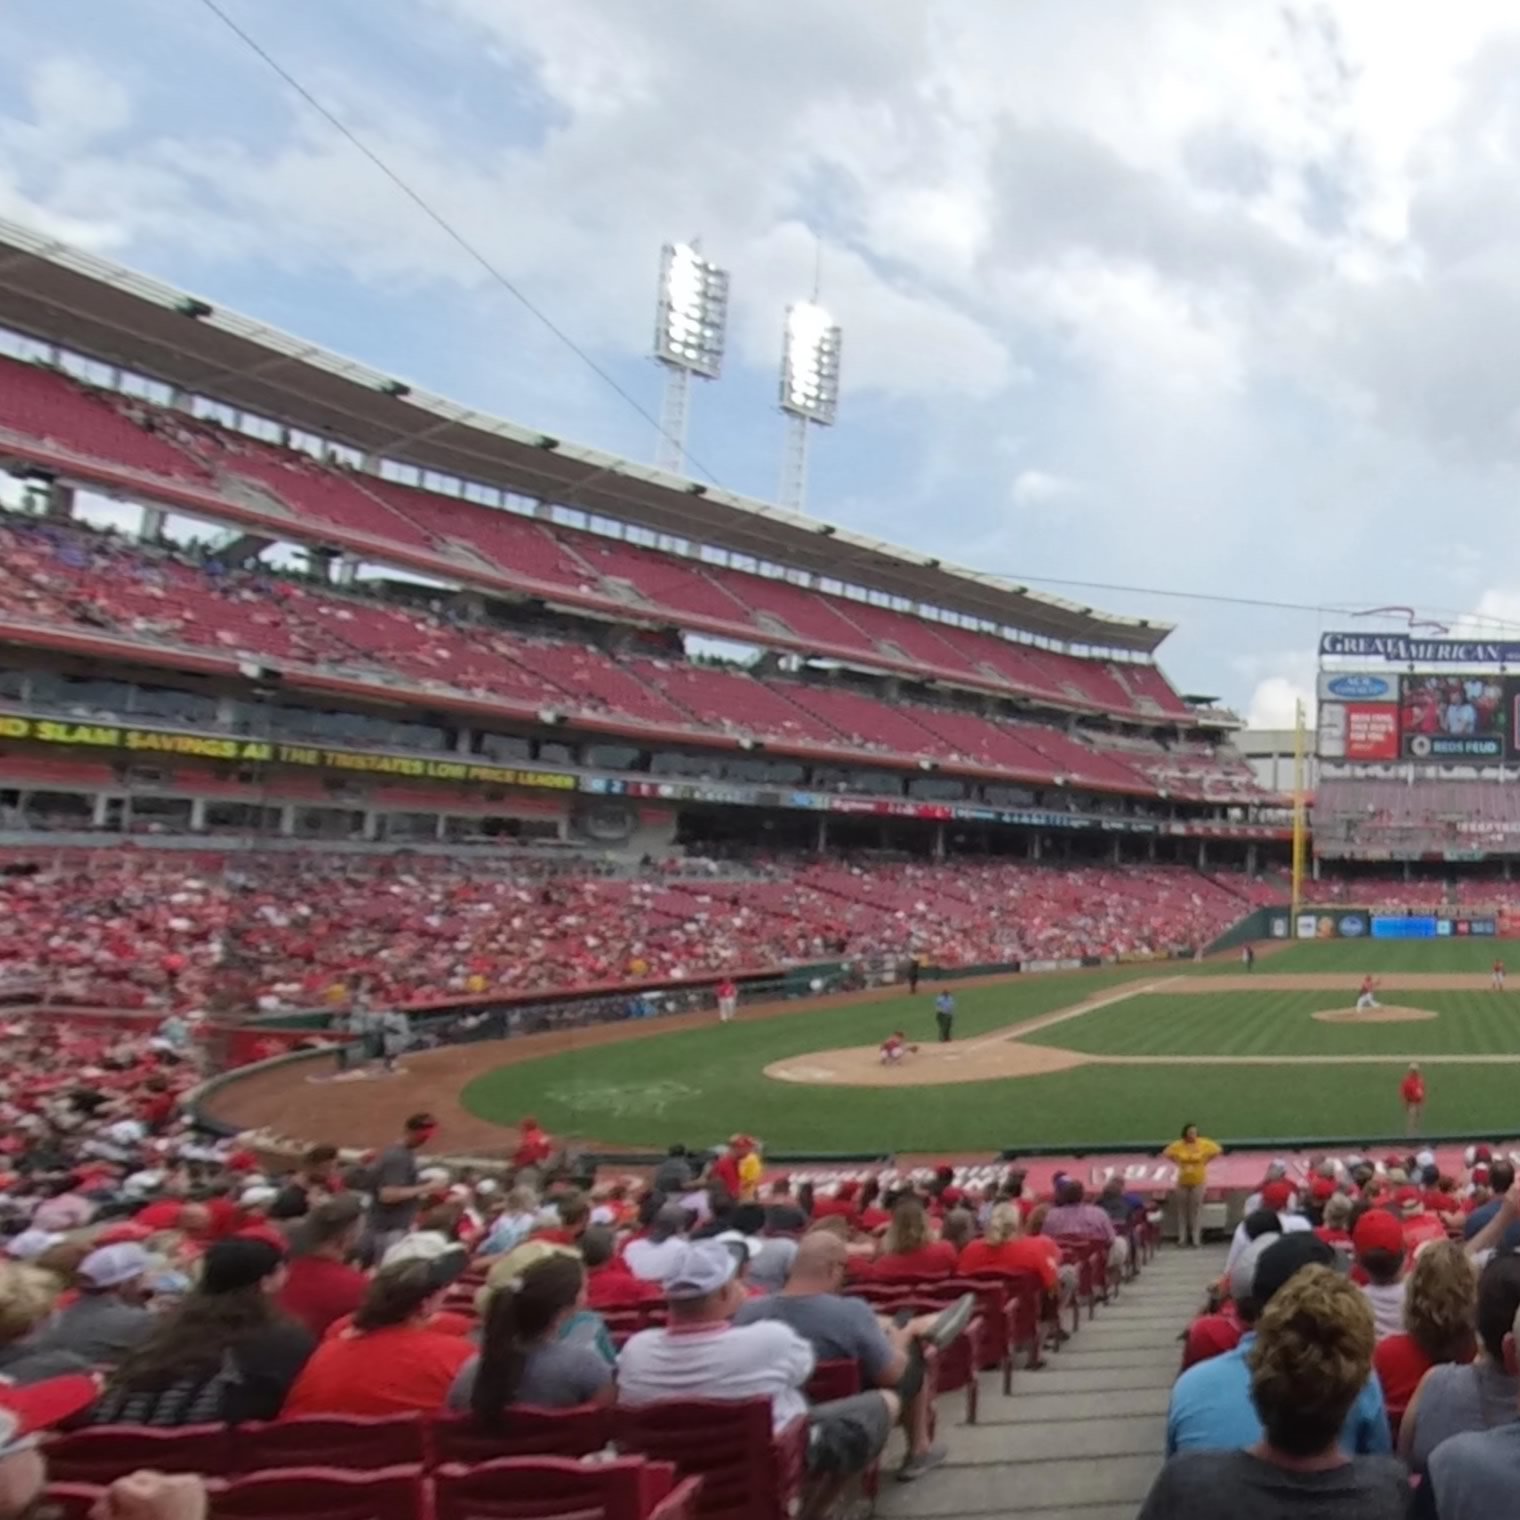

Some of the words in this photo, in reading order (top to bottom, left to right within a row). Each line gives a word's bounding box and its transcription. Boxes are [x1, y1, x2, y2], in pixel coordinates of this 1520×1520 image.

[1323, 634, 1394, 653] GREAT
[1391, 639, 1500, 661] AMERICAN
[36, 721, 119, 746] SLAM
[125, 730, 238, 758] SAVINGS
[278, 745, 318, 765] THE
[427, 762, 467, 780] LOW
[1433, 742, 1464, 753] REDS
[1464, 742, 1498, 753] FEUD
